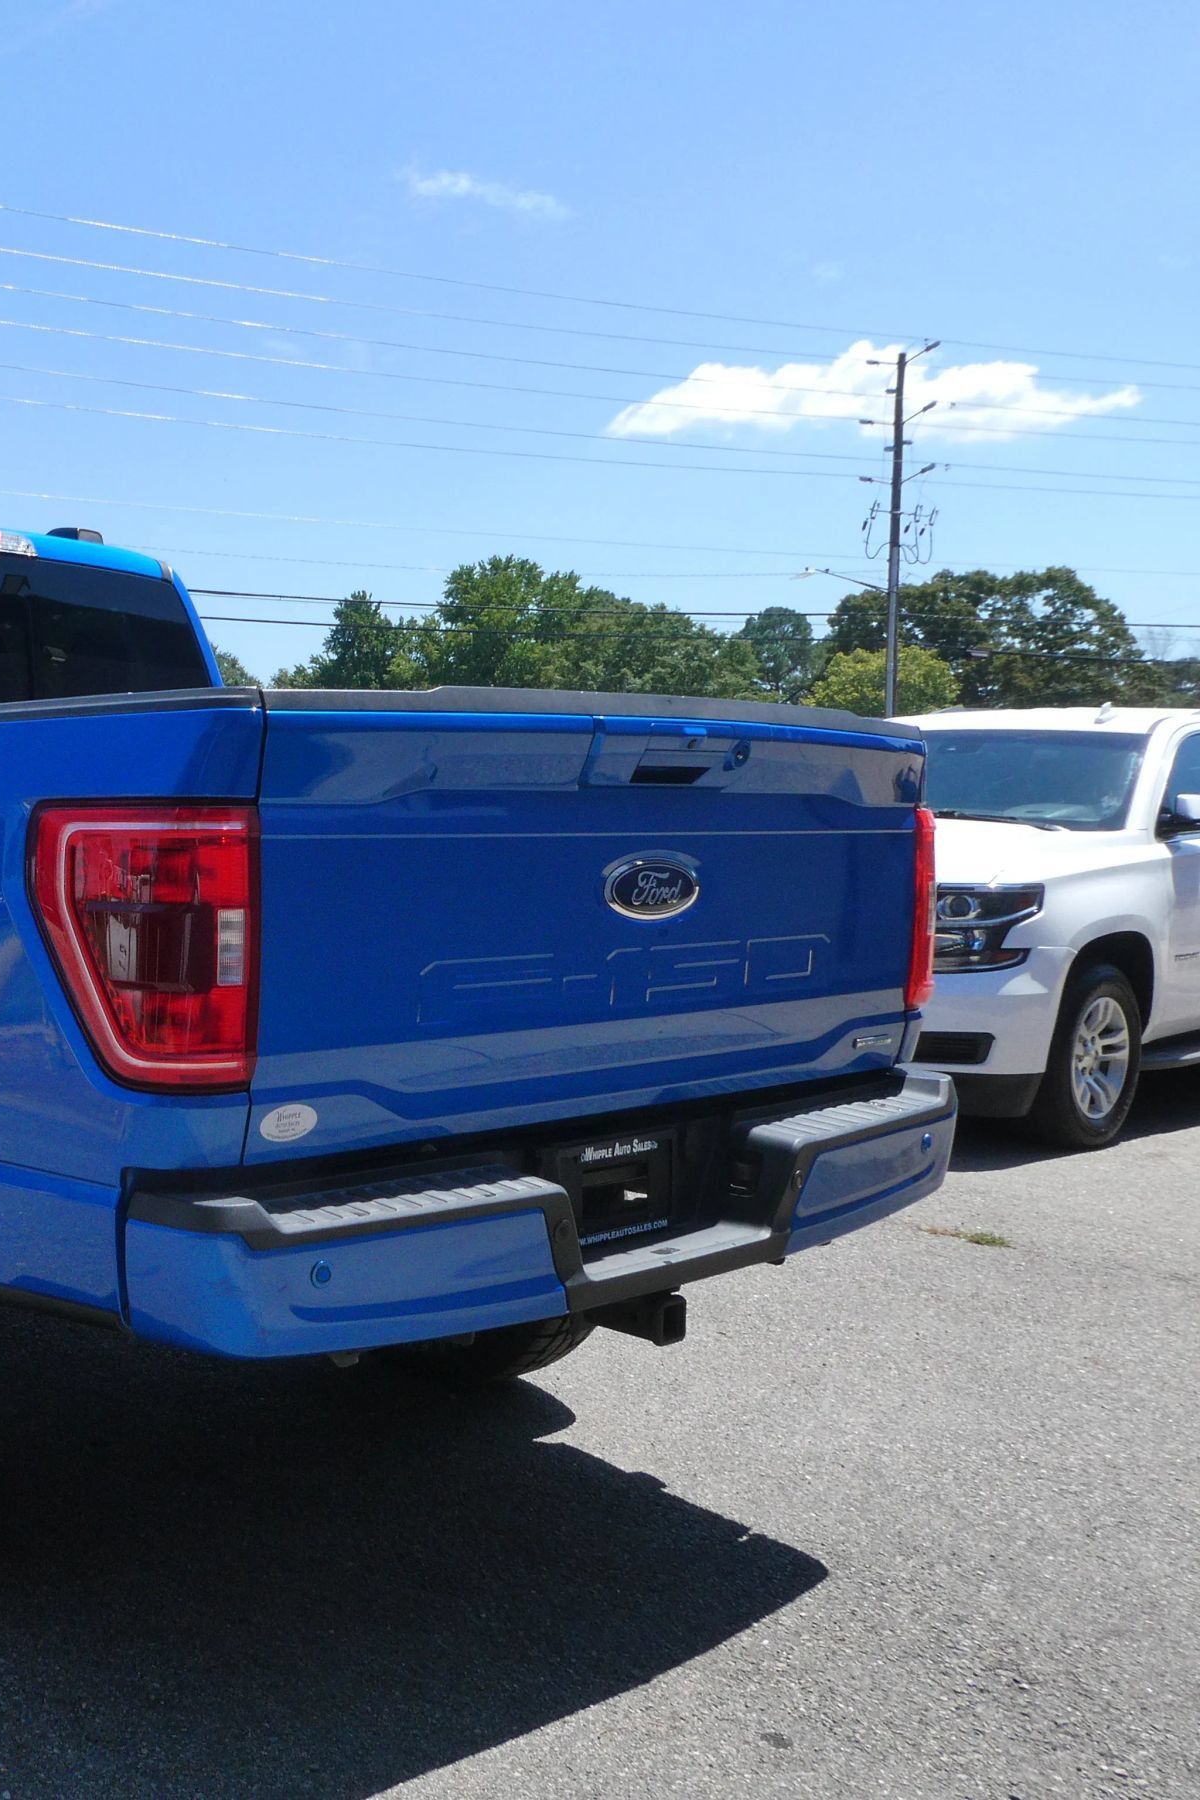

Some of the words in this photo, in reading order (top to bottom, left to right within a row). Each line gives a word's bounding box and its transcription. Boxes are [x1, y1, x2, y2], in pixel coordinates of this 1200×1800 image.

[631, 871, 682, 905] Ford
[585, 1146, 613, 1161] WHIPPLE
[614, 1142, 631, 1156] AUTO
[632, 1139, 652, 1153] SALES
